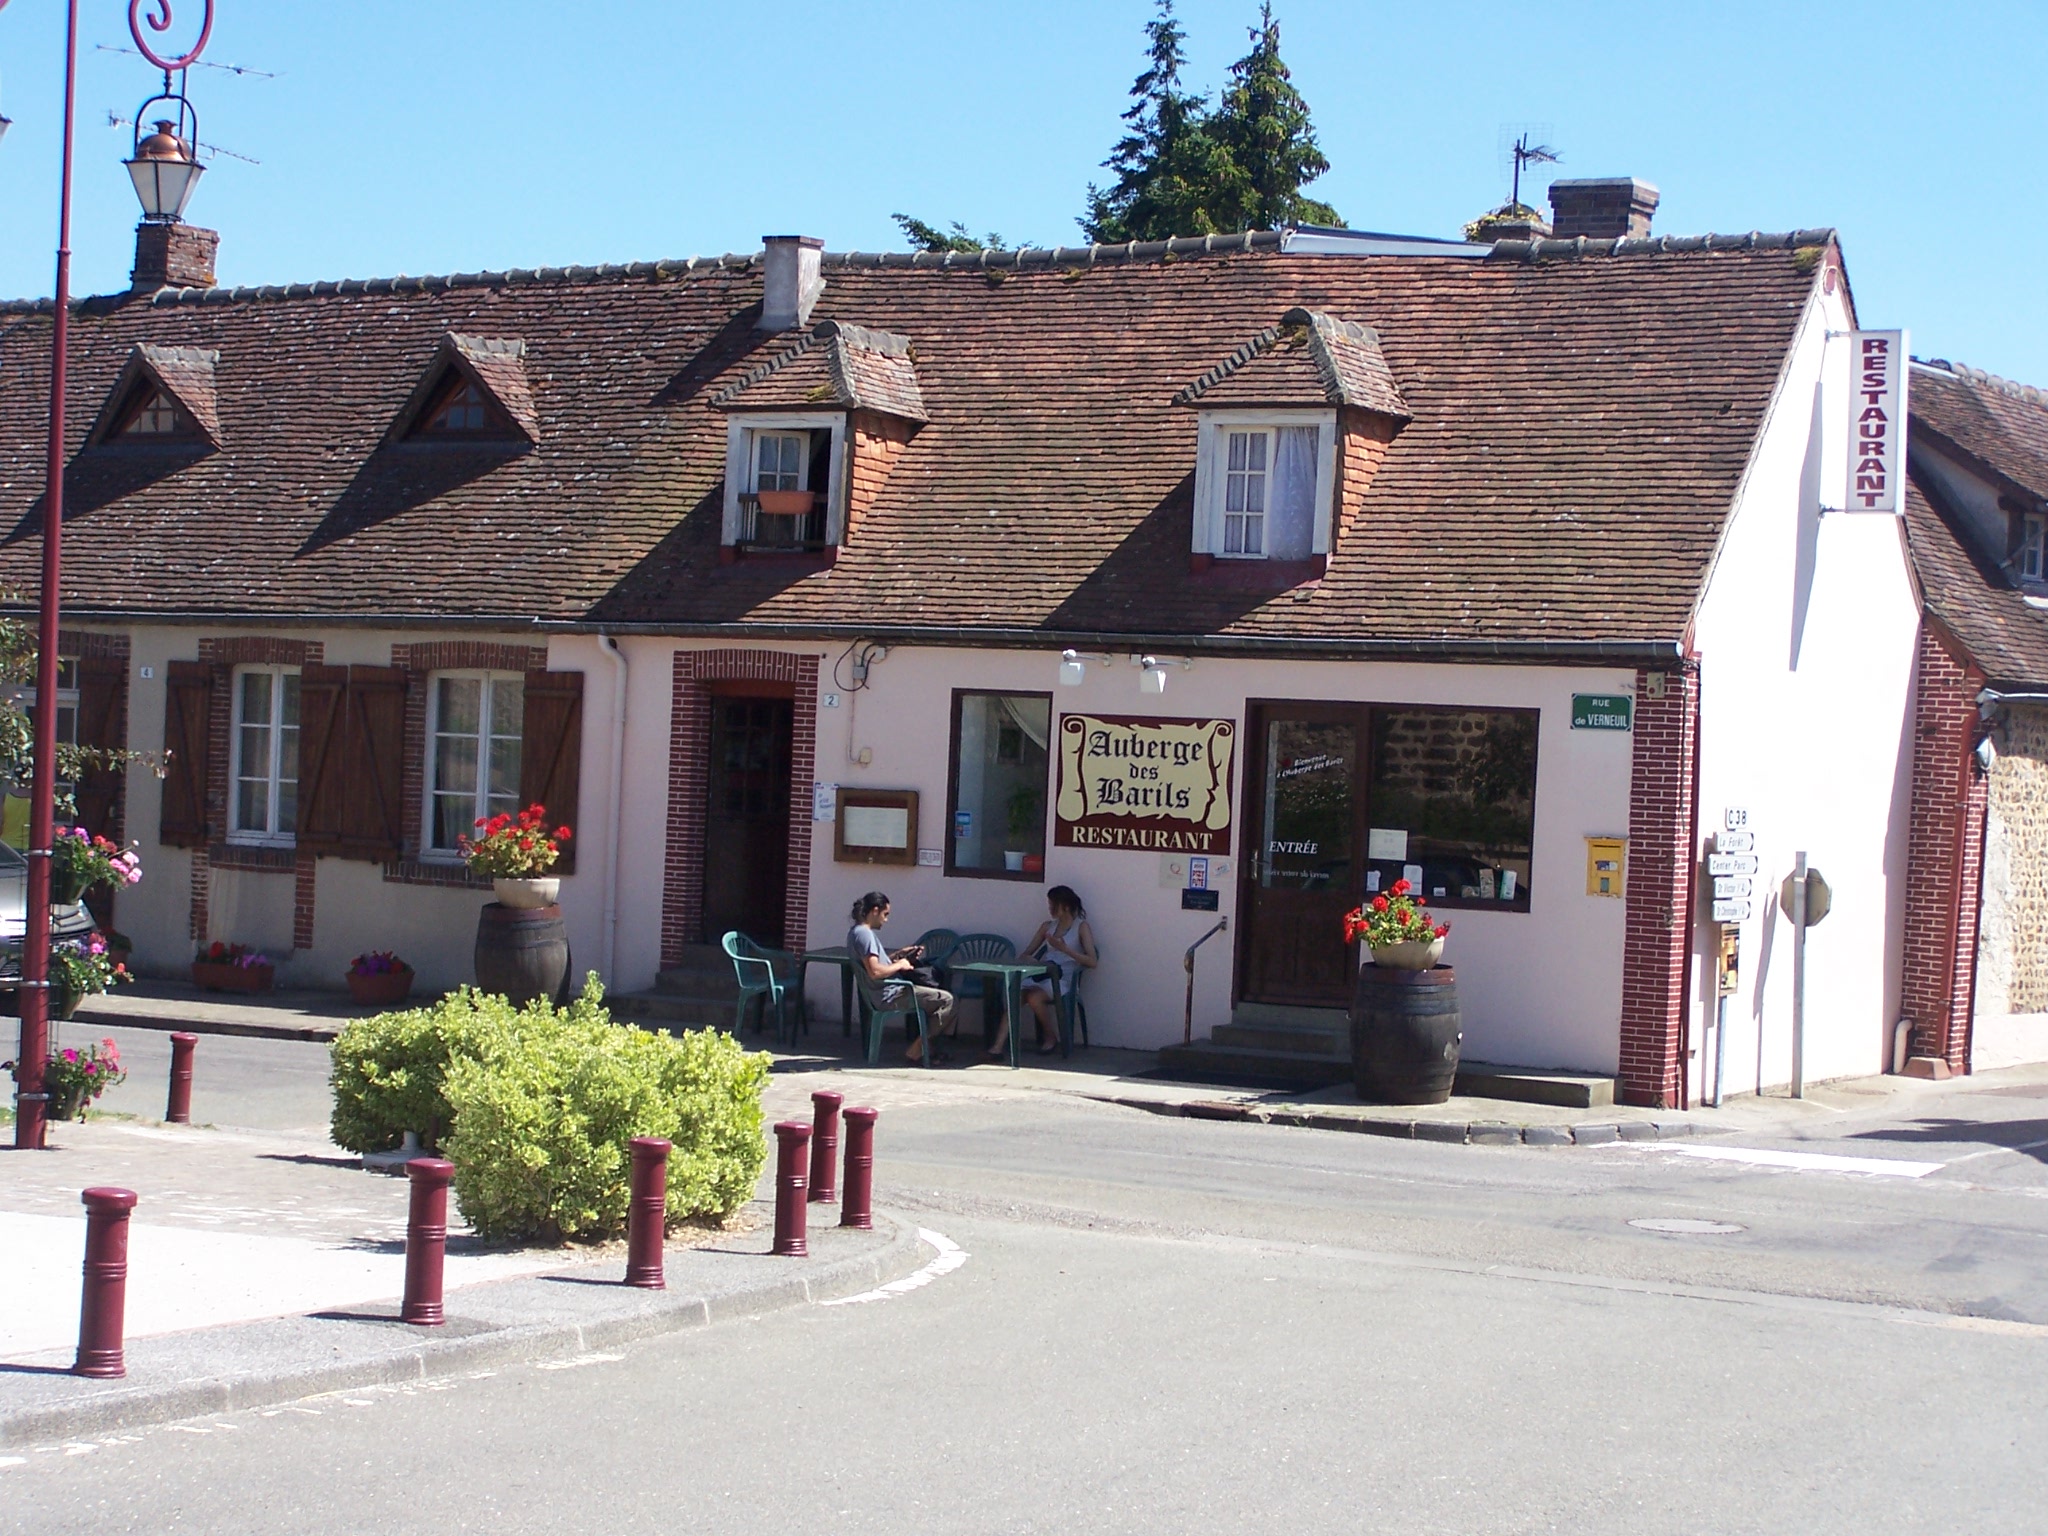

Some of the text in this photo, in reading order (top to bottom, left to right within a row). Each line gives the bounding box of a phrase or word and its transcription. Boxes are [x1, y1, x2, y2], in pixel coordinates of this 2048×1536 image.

[1856, 338, 1889, 507] RESTAURANT
[827, 696, 835, 705] 2
[1592, 699, 1610, 707] RUE
[1575, 714, 1627, 727] de VERNEUIL
[1088, 730, 1203, 765] Auberge
[1129, 763, 1159, 779] des
[1096, 777, 1191, 809] Barils
[1071, 826, 1213, 850] RESTAURANT
[1269, 839, 1318, 854] ENTRÉE
